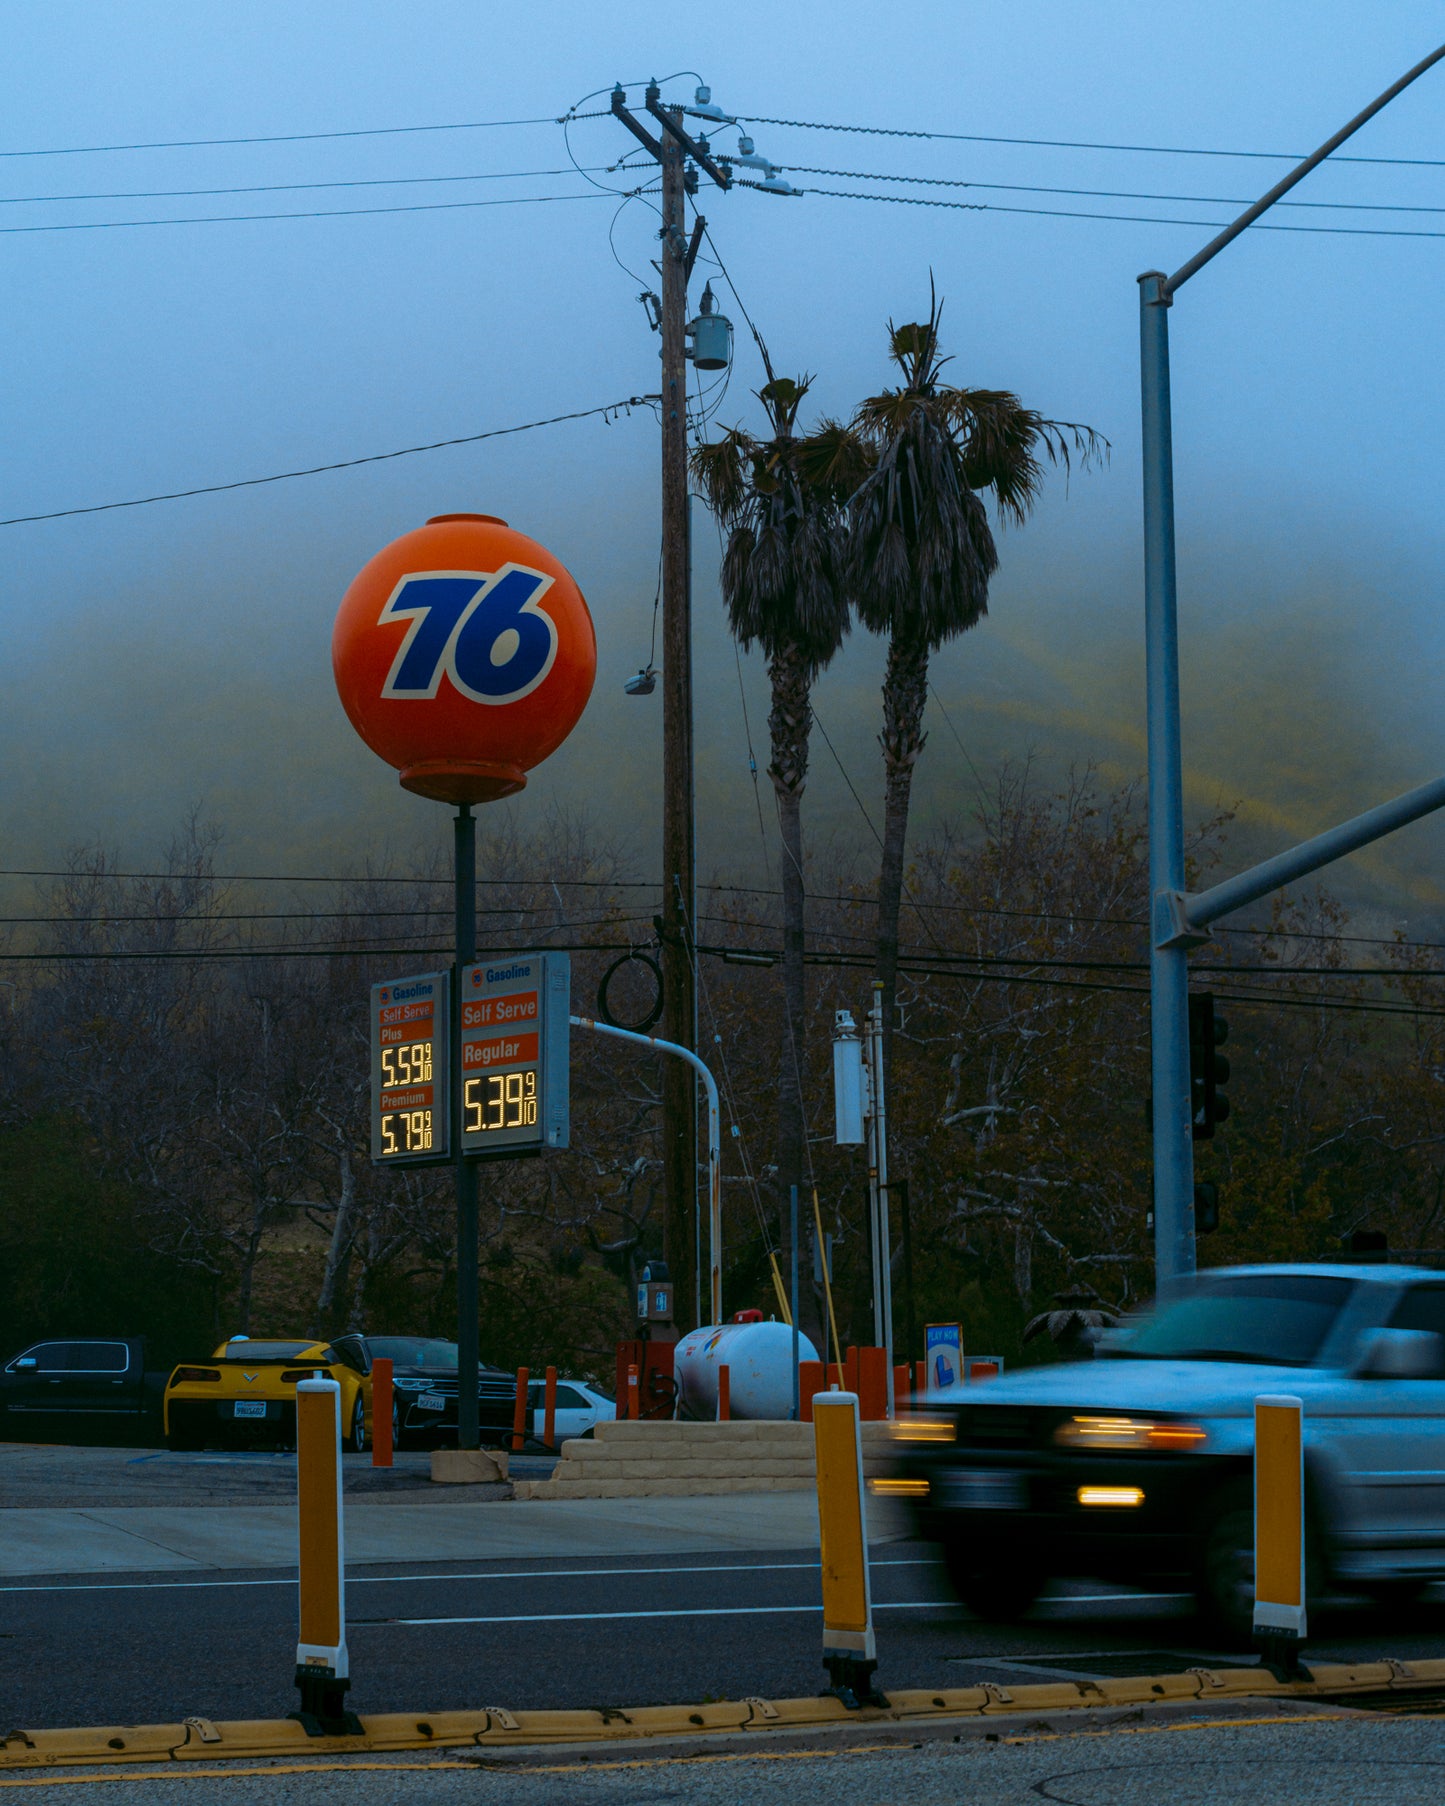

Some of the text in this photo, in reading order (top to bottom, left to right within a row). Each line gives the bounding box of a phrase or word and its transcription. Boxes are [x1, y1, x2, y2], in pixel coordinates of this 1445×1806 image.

[376, 561, 559, 706] 76
[486, 965, 531, 983] Gasoline
[393, 983, 433, 1001] Gasoline
[383, 1004, 430, 1023] Self Serve
[464, 999, 536, 1025] Self Serve
[382, 1027, 402, 1042] Plus
[464, 1041, 520, 1065] Regular
[382, 1092, 425, 1109] Premium
[928, 1330, 943, 1341] PLAY
